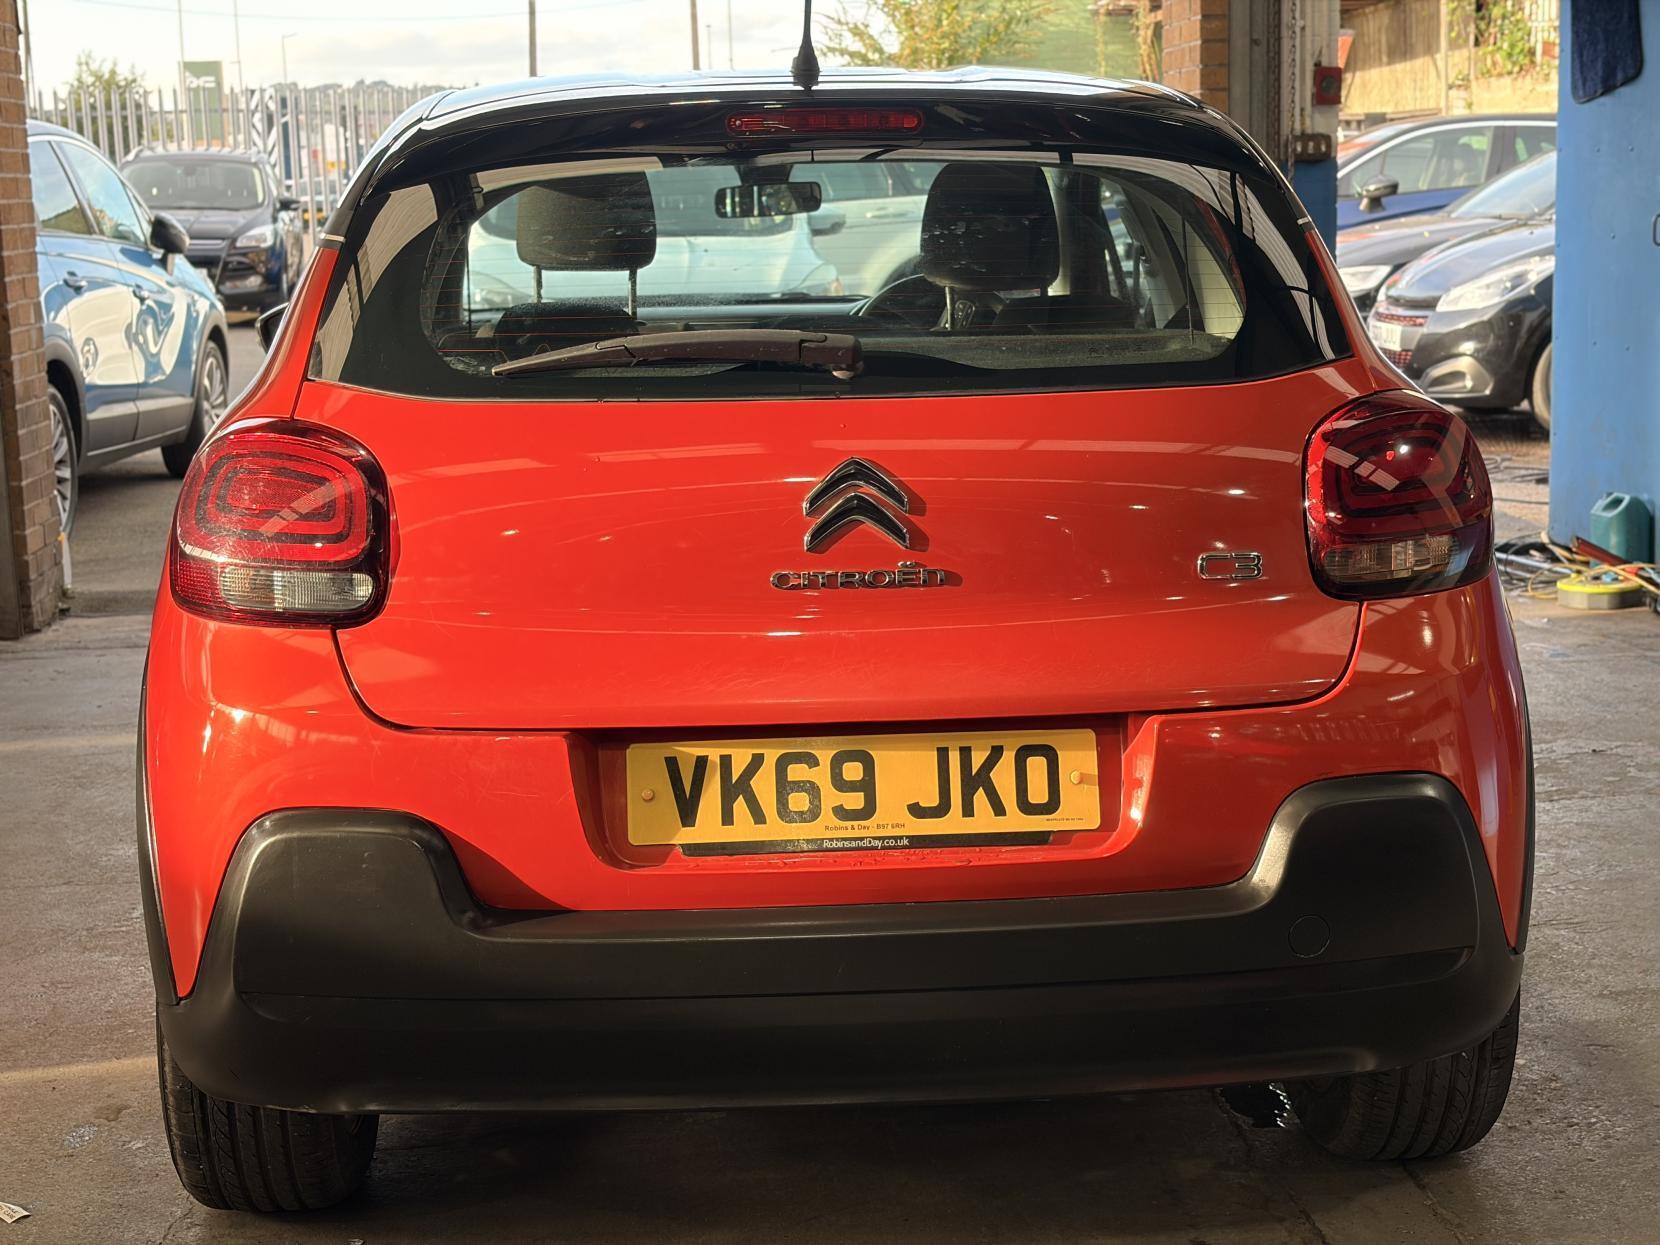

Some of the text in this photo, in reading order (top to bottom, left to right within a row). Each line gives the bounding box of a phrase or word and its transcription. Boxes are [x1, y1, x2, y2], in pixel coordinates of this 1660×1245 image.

[1197, 552, 1263, 579] C3
[664, 743, 1061, 829] VK69 JKO
[824, 824, 849, 832] Robins
[858, 823, 870, 831] Day
[823, 837, 909, 849] RobinsandDay.co.uk
